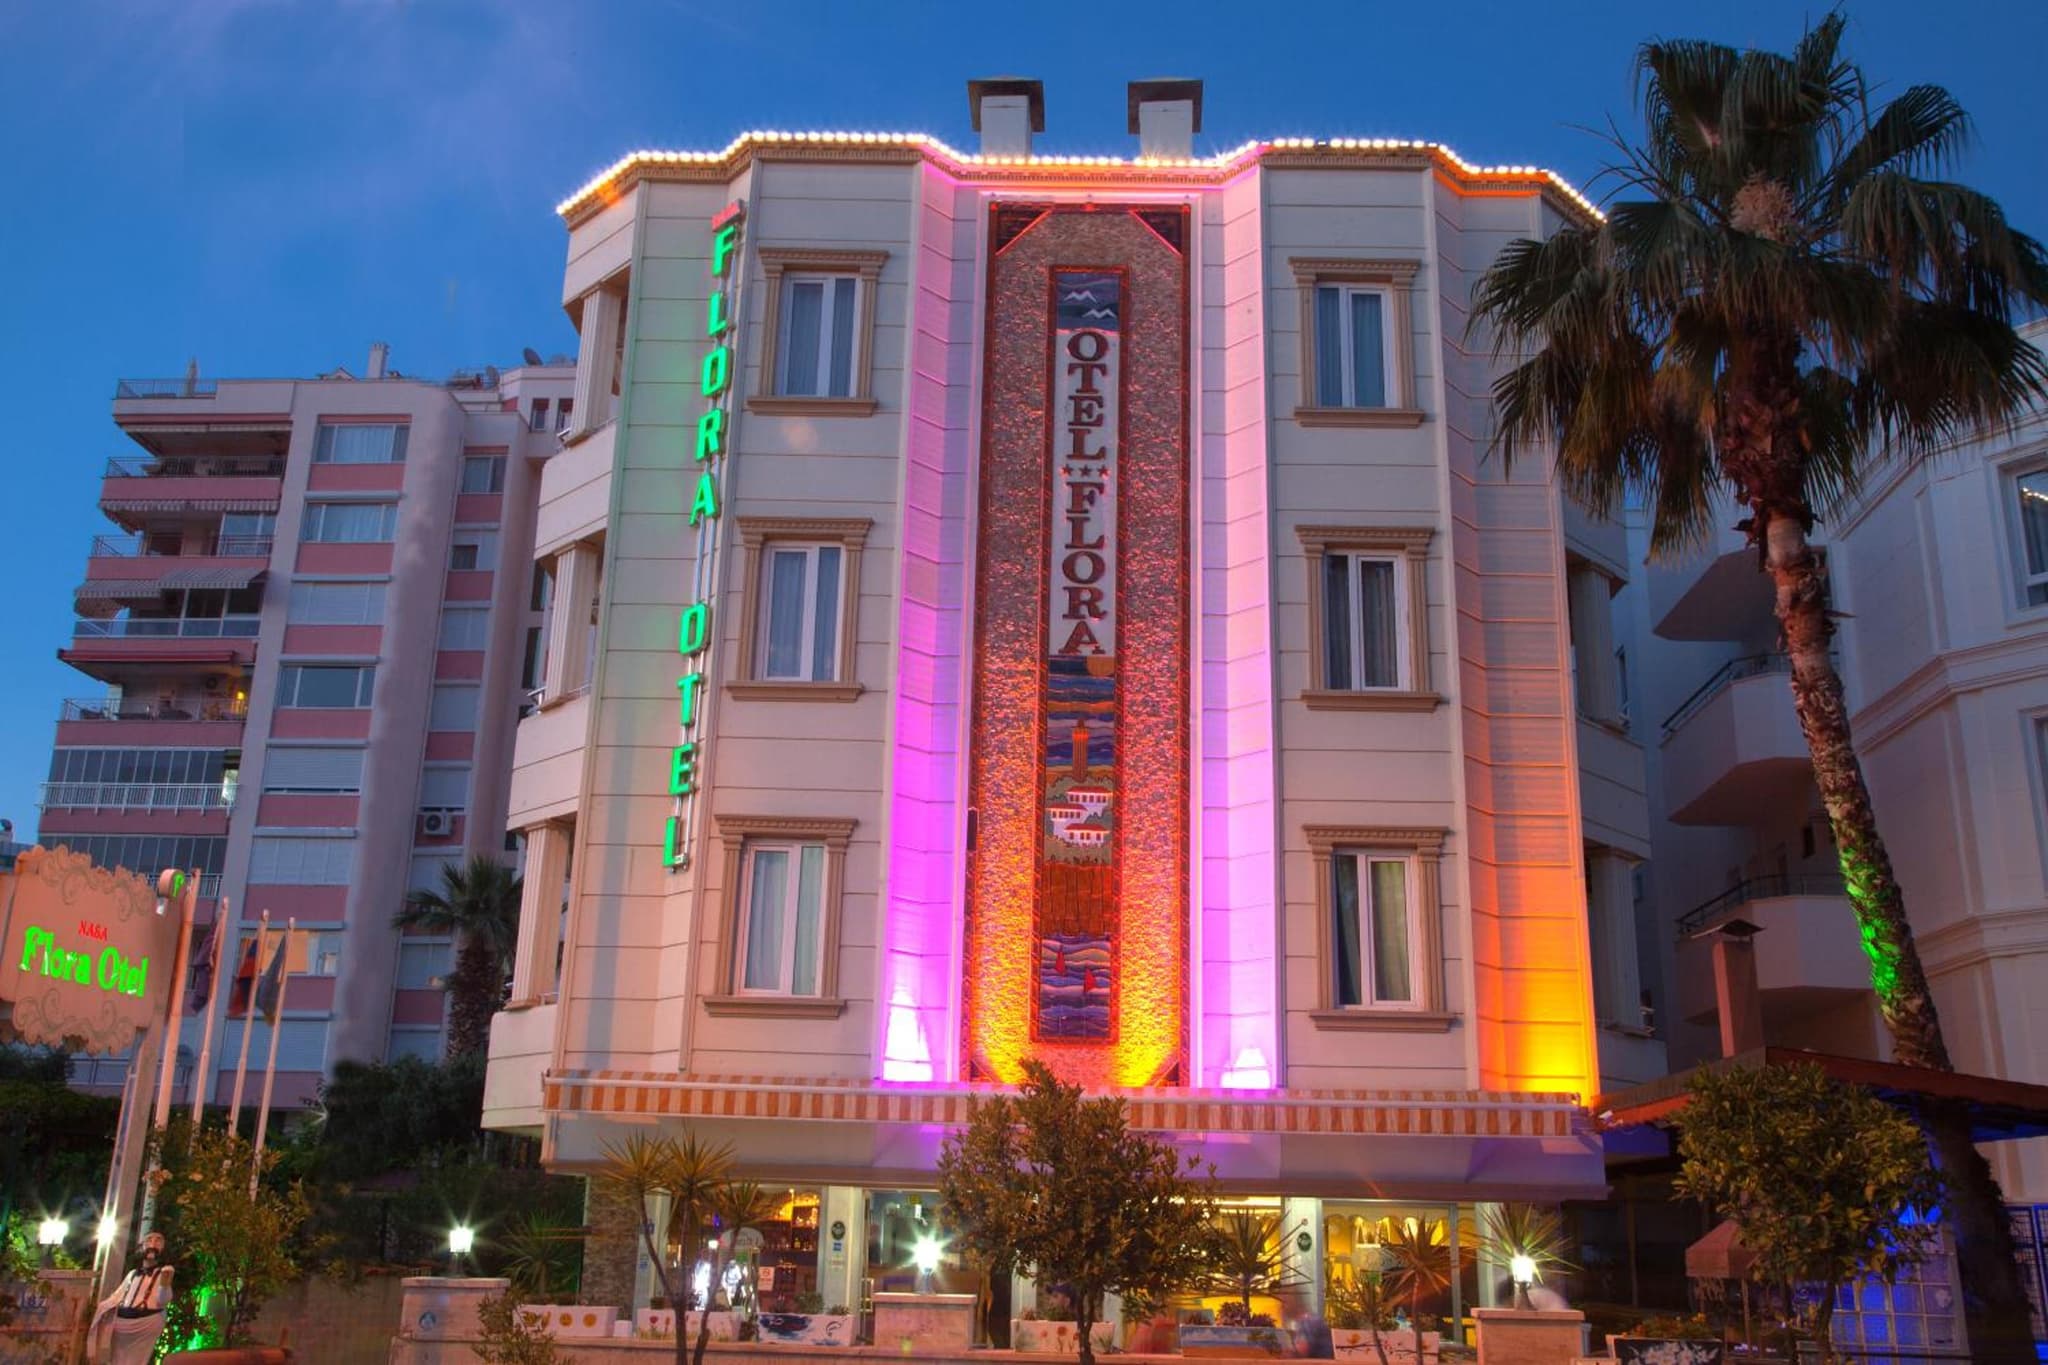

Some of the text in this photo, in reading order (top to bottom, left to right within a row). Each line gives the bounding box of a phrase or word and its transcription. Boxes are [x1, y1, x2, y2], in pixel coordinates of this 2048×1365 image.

[689, 225, 735, 527] FLORA
[1058, 332, 1109, 655] OTEL FLORA
[662, 603, 709, 868] OTEL
[19, 925, 149, 998] Flora Otel
